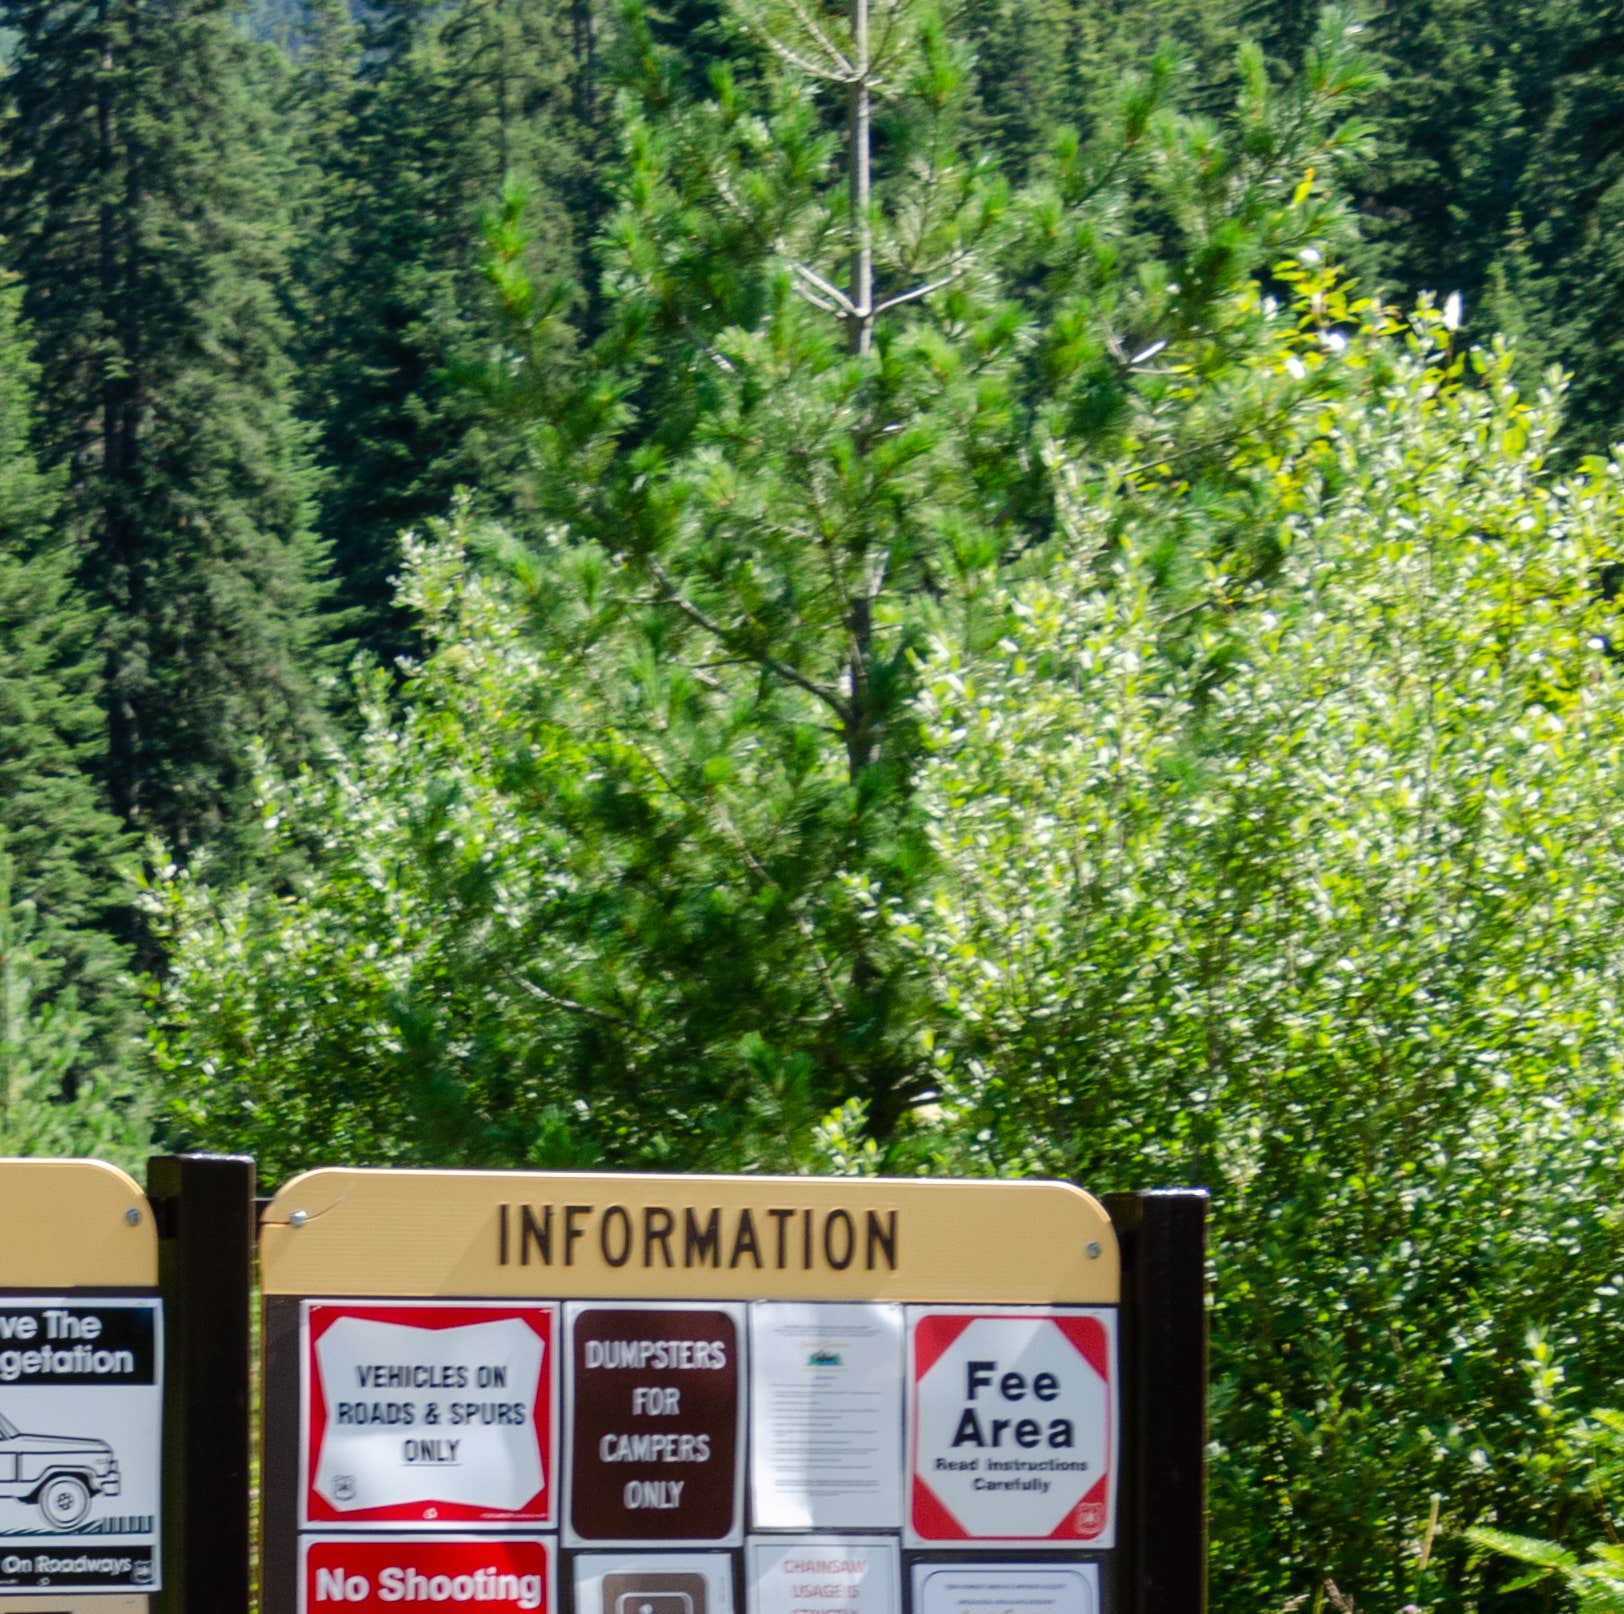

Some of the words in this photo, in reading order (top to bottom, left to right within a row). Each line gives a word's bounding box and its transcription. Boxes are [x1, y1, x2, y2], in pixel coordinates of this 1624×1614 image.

[498, 1203, 899, 1270] INFORMATION
[41, 1310, 103, 1340] The
[584, 1340, 727, 1370] DUMPSTERS
[355, 1364, 469, 1388] VEHICLES
[476, 1364, 508, 1388] ON
[965, 1360, 1062, 1402] Fee
[337, 1401, 416, 1425] ROADS
[424, 1402, 442, 1425] &
[449, 1401, 527, 1425] SPURS
[632, 1387, 681, 1416] FOR
[950, 1407, 1077, 1449] Area
[402, 1439, 461, 1463] ONLY
[600, 1433, 711, 1463] CAMPERS
[935, 1458, 979, 1471] Read
[623, 1479, 685, 1510] ONLY
[972, 1477, 1051, 1494] Carefully
[3, 1556, 33, 1574] On
[34, 1555, 133, 1575] Roadways
[783, 1559, 866, 1574] CHAINSAW
[315, 1567, 370, 1602] No
[377, 1565, 542, 1610] Shooting
[791, 1584, 842, 1598] USAGE
